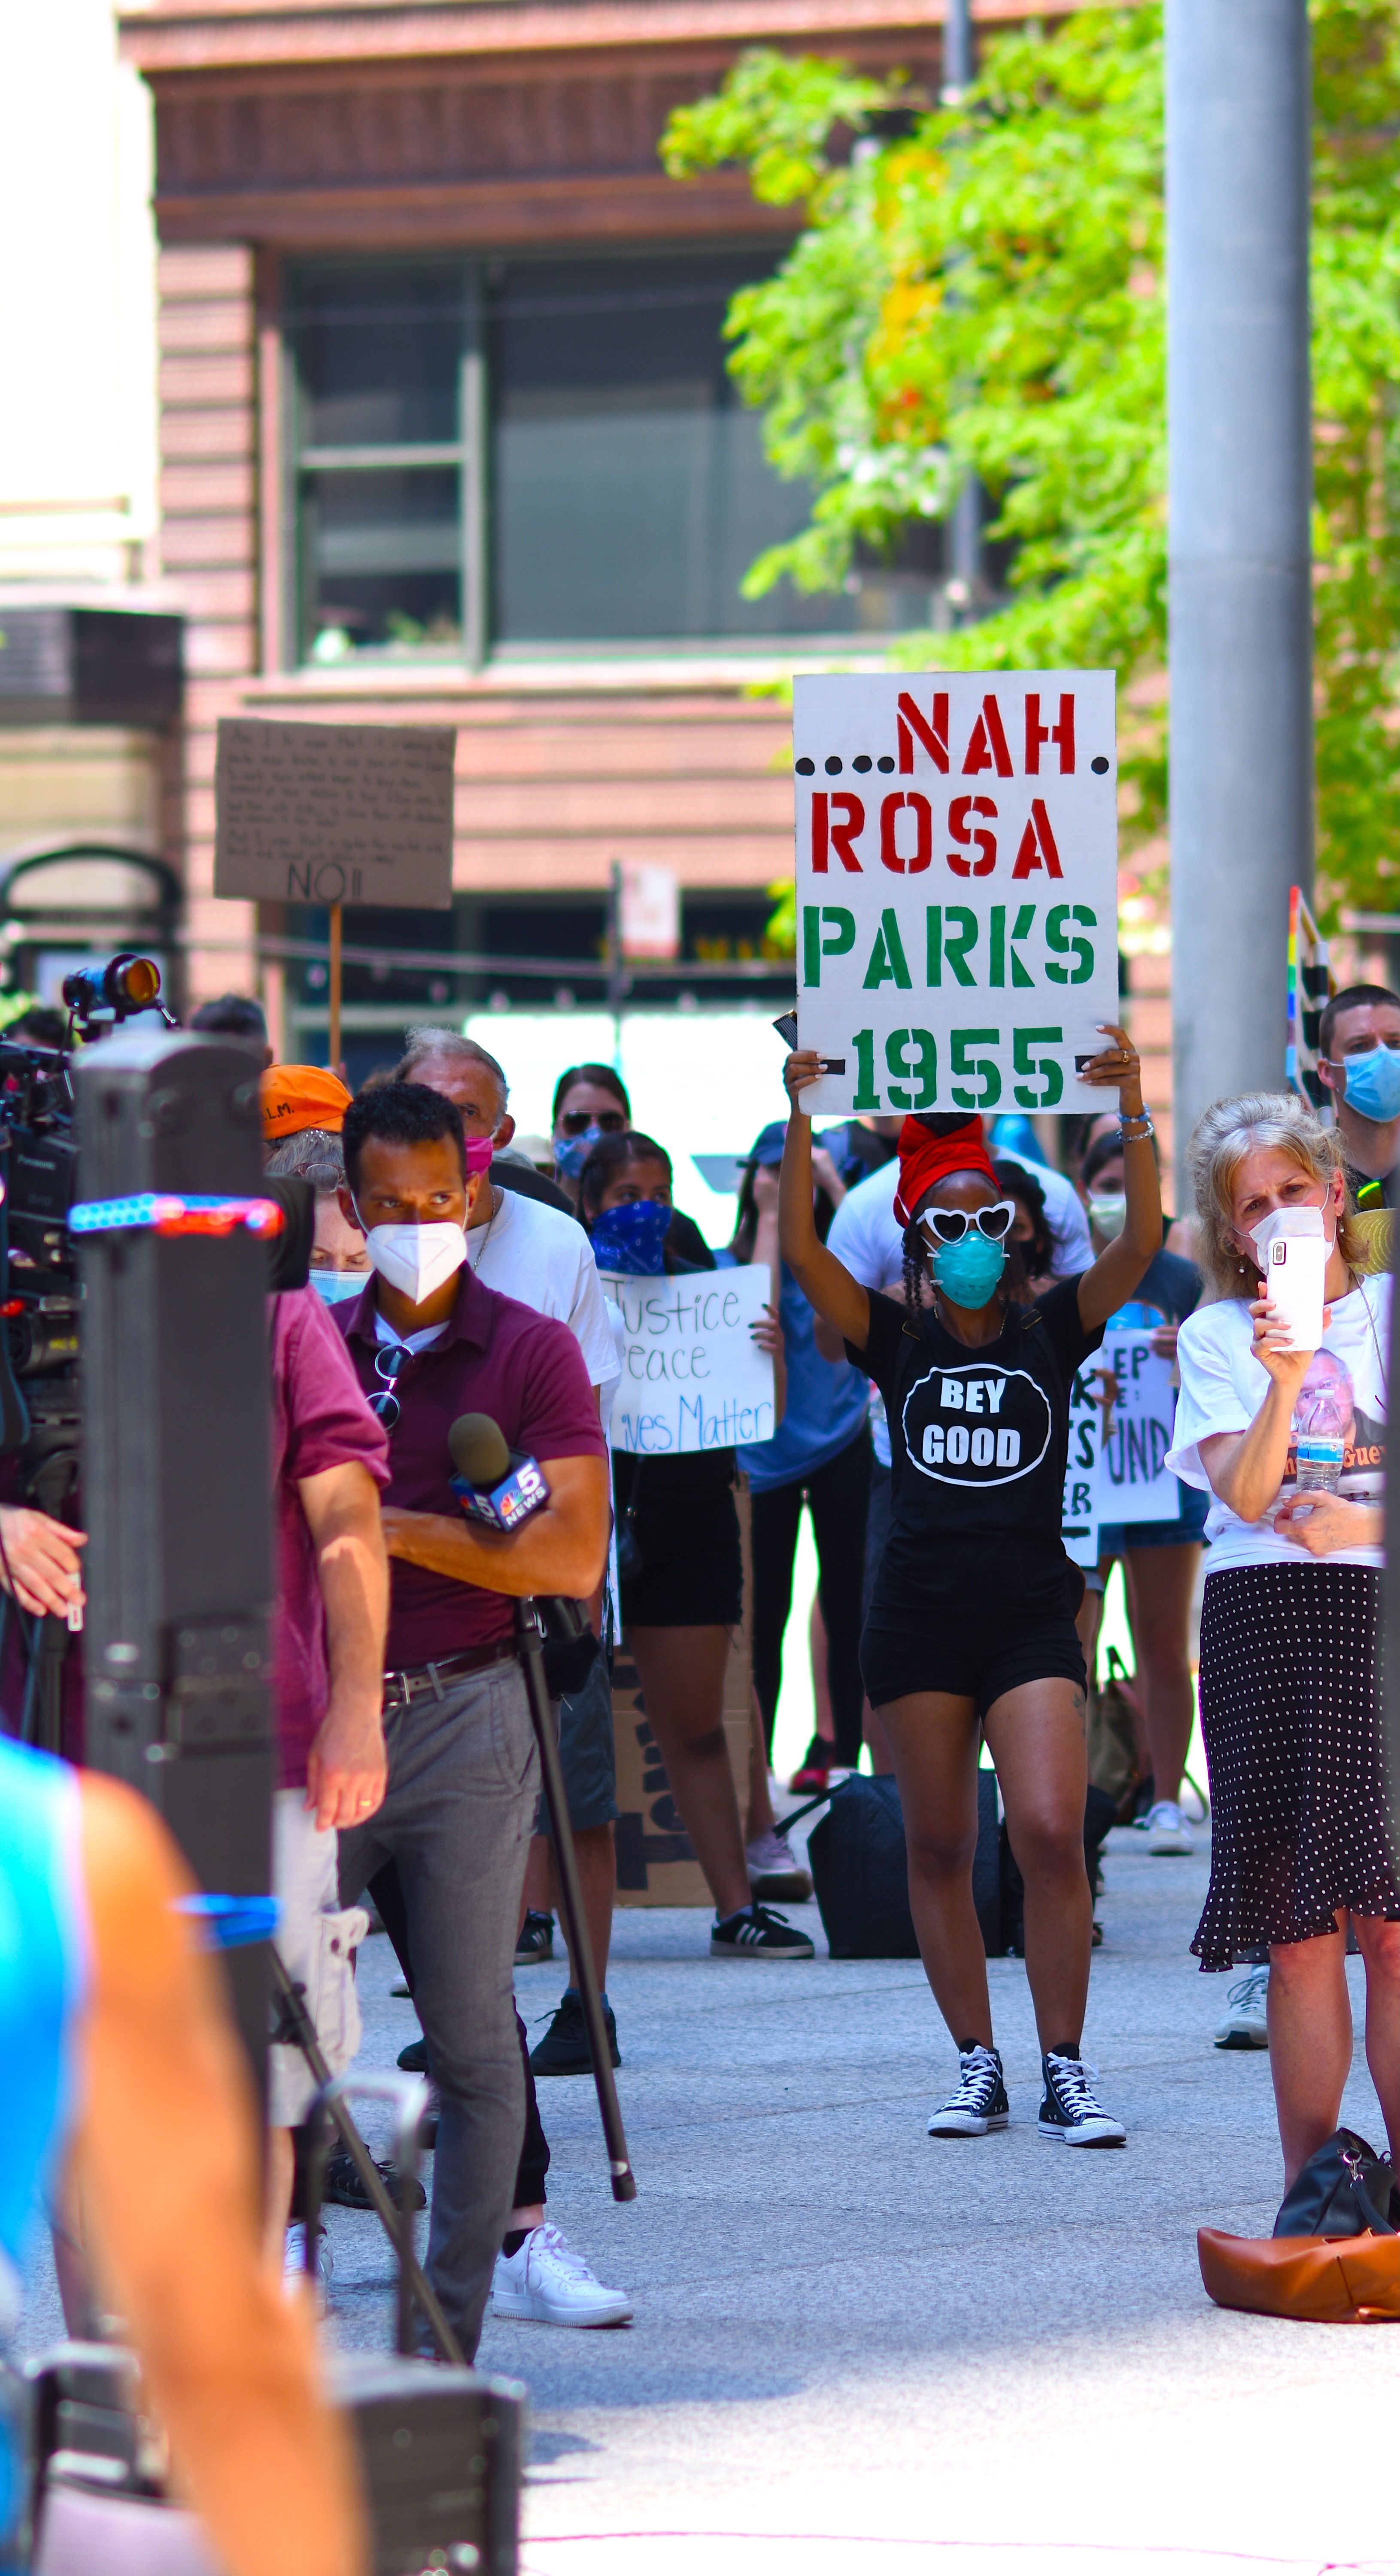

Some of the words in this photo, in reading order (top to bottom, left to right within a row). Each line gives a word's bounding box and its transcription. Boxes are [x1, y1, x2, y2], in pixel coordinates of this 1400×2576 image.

[811, 791, 1064, 879] ROSA
[803, 904, 1097, 990] PARKS
[264, 1102, 295, 1121] .L.M.
[623, 1345, 710, 1381] eace
[1103, 1346, 1150, 1381] EP
[940, 1377, 1006, 1414] BEY
[1070, 1368, 1098, 1411] K
[1116, 1387, 1140, 1409] E:
[613, 1413, 673, 1452] ives
[678, 1394, 772, 1453] Matter
[922, 1424, 1021, 1467] GOOD
[1106, 1417, 1170, 1486] UND
[1342, 1443, 1387, 1468] Gue
[516, 1462, 541, 1495] 5
[505, 1486, 547, 1526] NEWS
